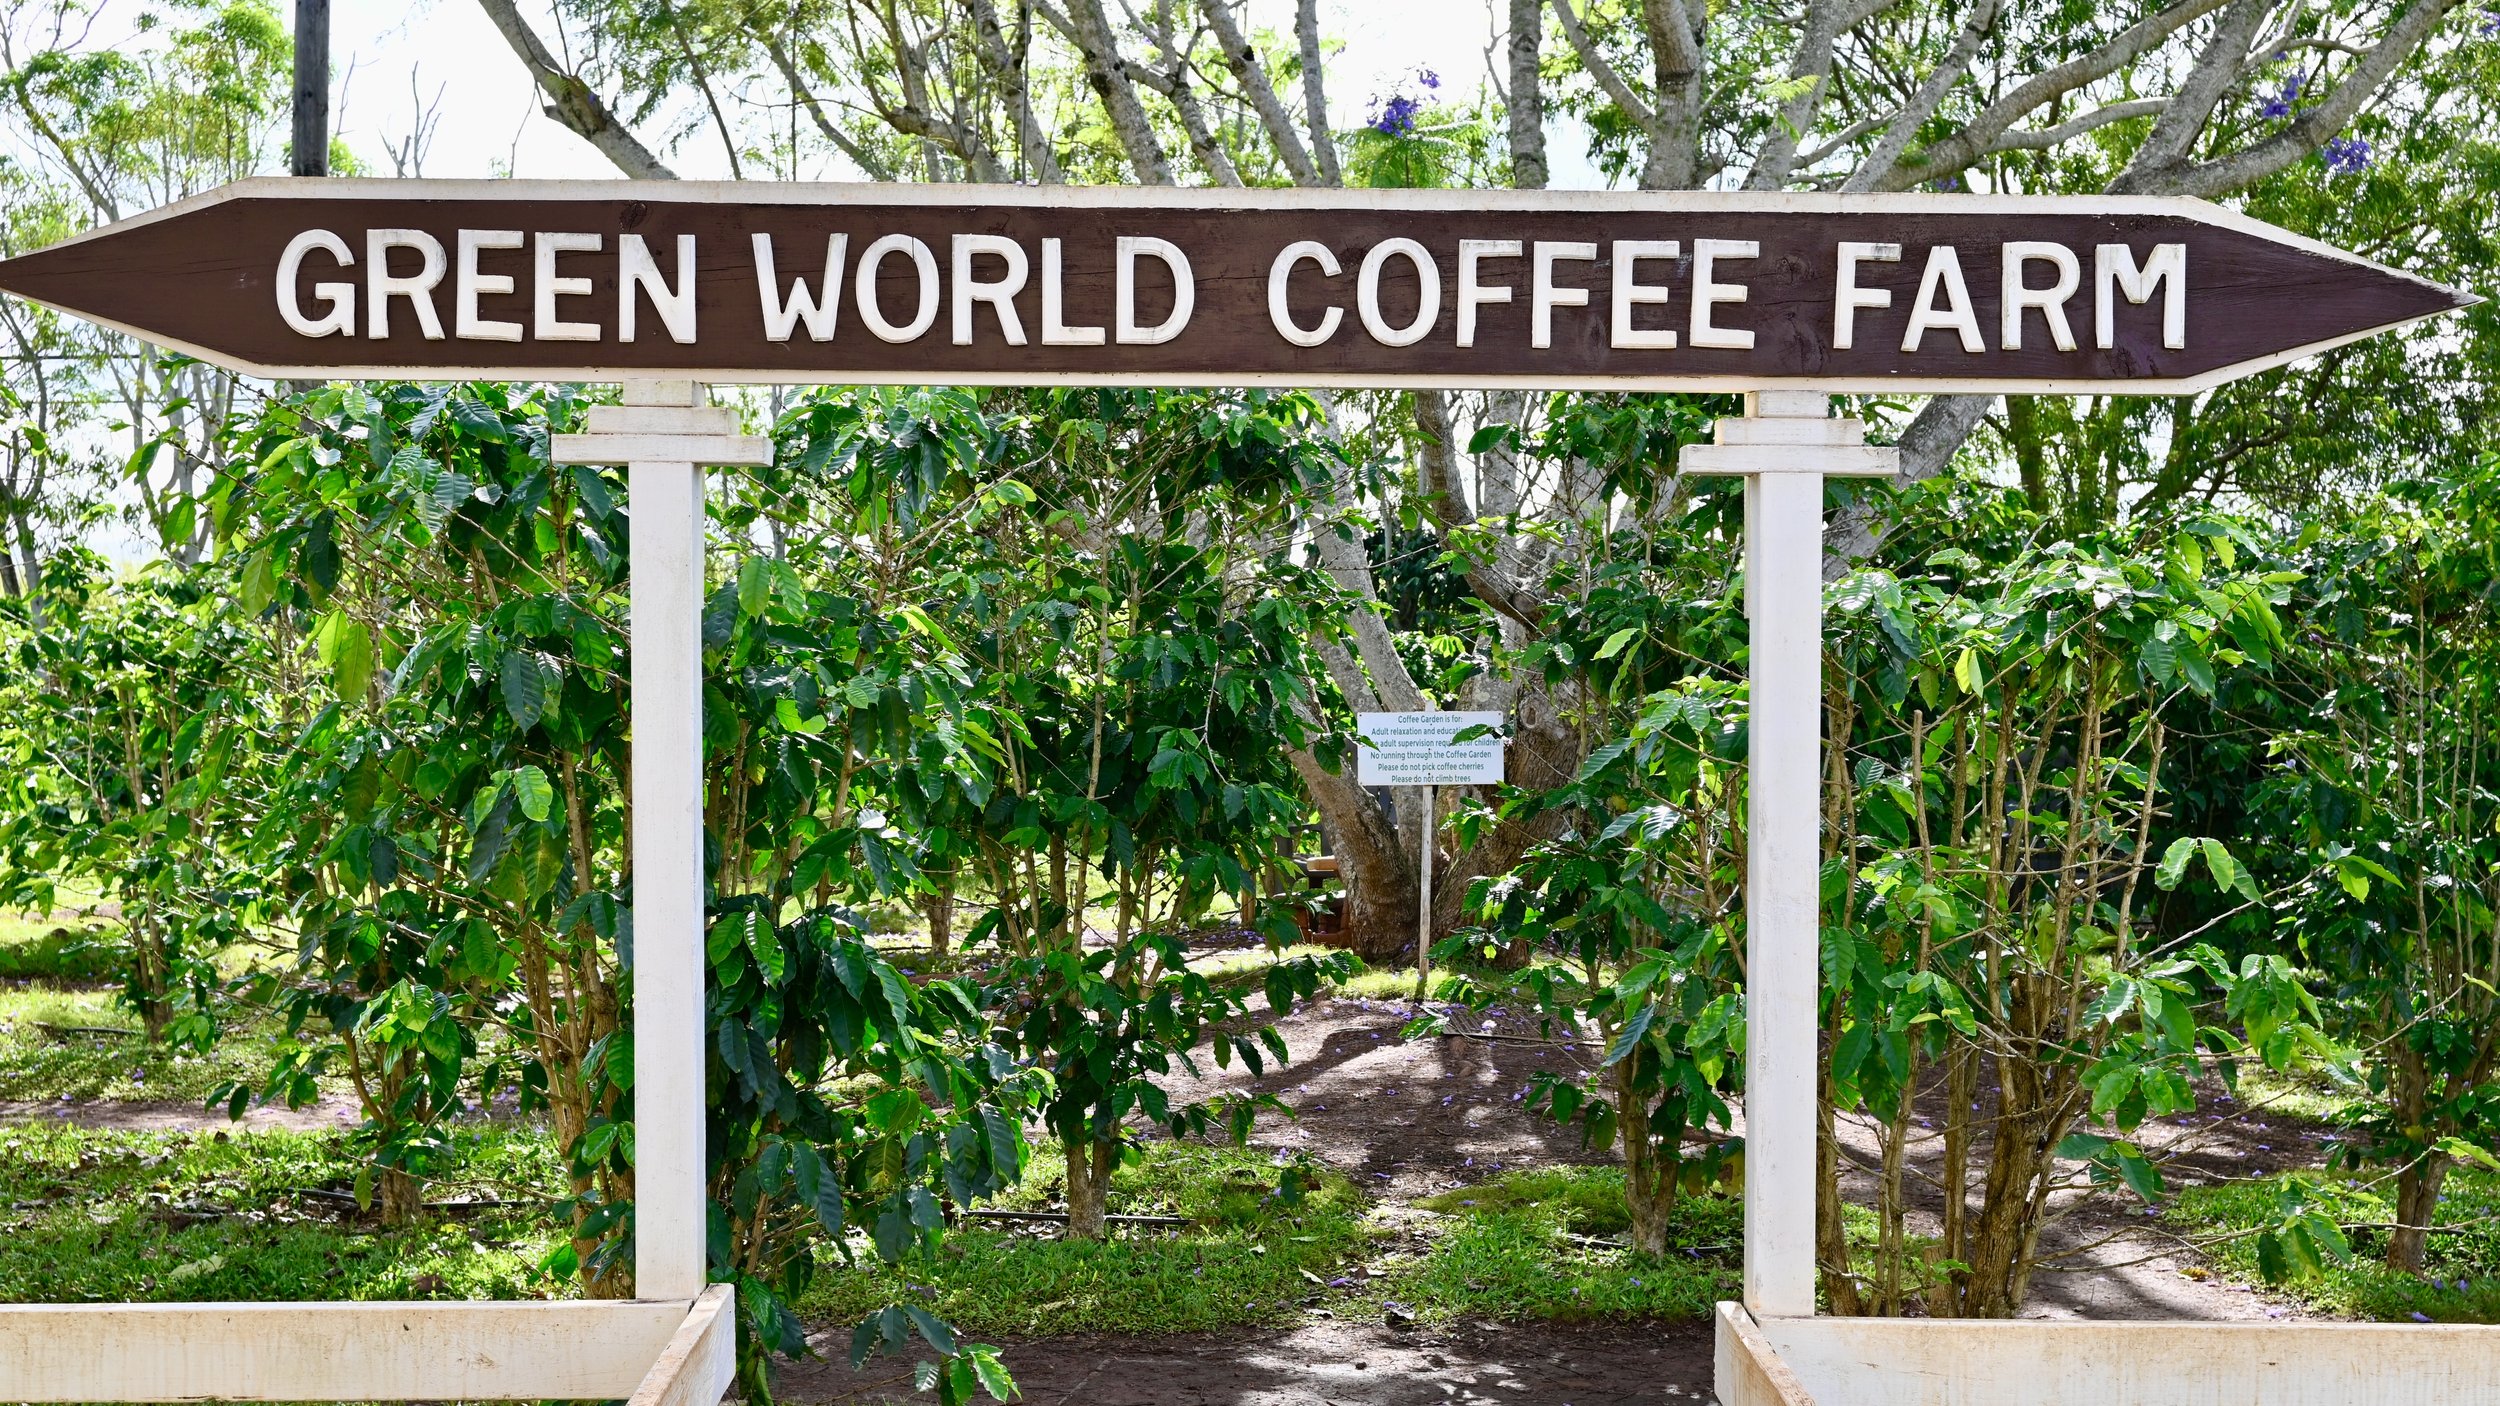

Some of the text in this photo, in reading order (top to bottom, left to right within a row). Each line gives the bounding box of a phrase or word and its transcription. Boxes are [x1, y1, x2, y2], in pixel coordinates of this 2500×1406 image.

[276, 229, 2186, 352] GREEN WORLD COFFEE FARM
[1398, 715, 1420, 723] Coffee
[1421, 715, 1443, 723] Garden
[1391, 727, 1422, 735] relaxation
[1424, 727, 1435, 735] and
[1398, 740, 1434, 748] supervision
[1475, 737, 1500, 745] children
[1381, 752, 1405, 760] running
[1407, 751, 1432, 760] through
[1446, 750, 1467, 758] Coffee
[1469, 750, 1492, 758] Garden
[1378, 763, 1398, 771] Please
[1400, 763, 1408, 771] do
[1422, 763, 1435, 772] pick
[1437, 762, 1457, 770] coffee
[1459, 762, 1484, 770] cherries
[1392, 775, 1412, 783] Please
[1436, 774, 1453, 782] climb
[1455, 774, 1471, 782] trees
